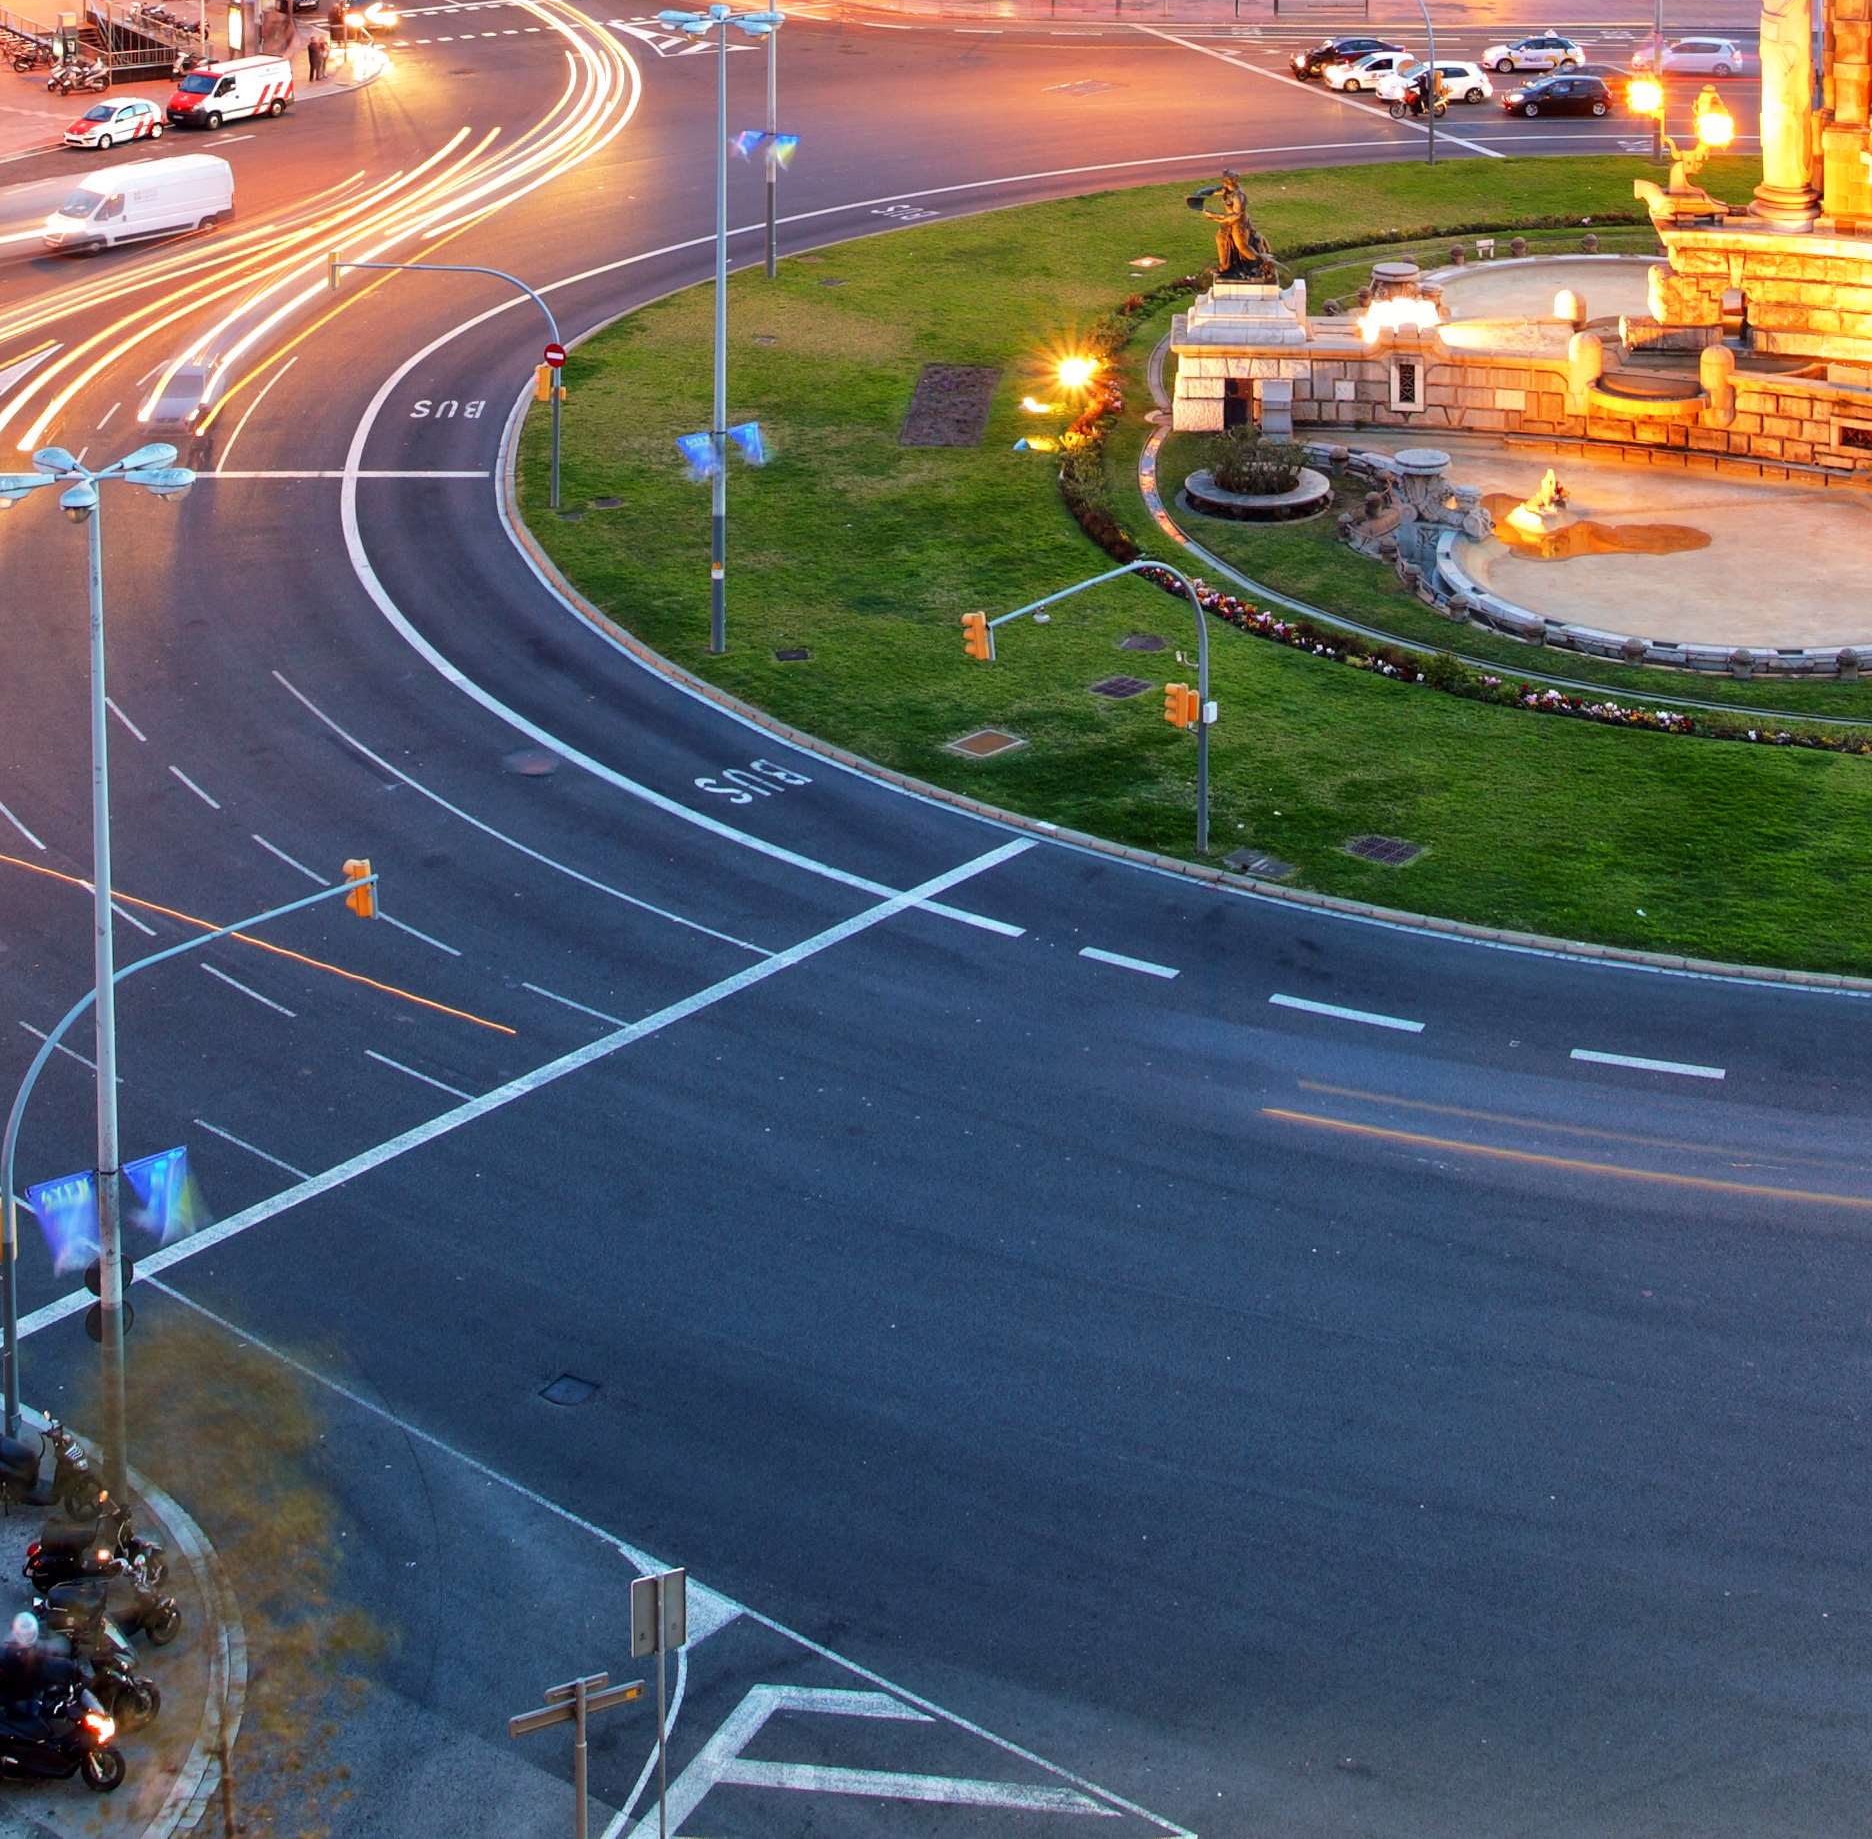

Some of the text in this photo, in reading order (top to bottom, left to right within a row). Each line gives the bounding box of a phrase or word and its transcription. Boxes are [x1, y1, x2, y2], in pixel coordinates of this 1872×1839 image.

[870, 204, 941, 221] BUS
[409, 400, 486, 418] BUS
[694, 759, 813, 804] BUS
